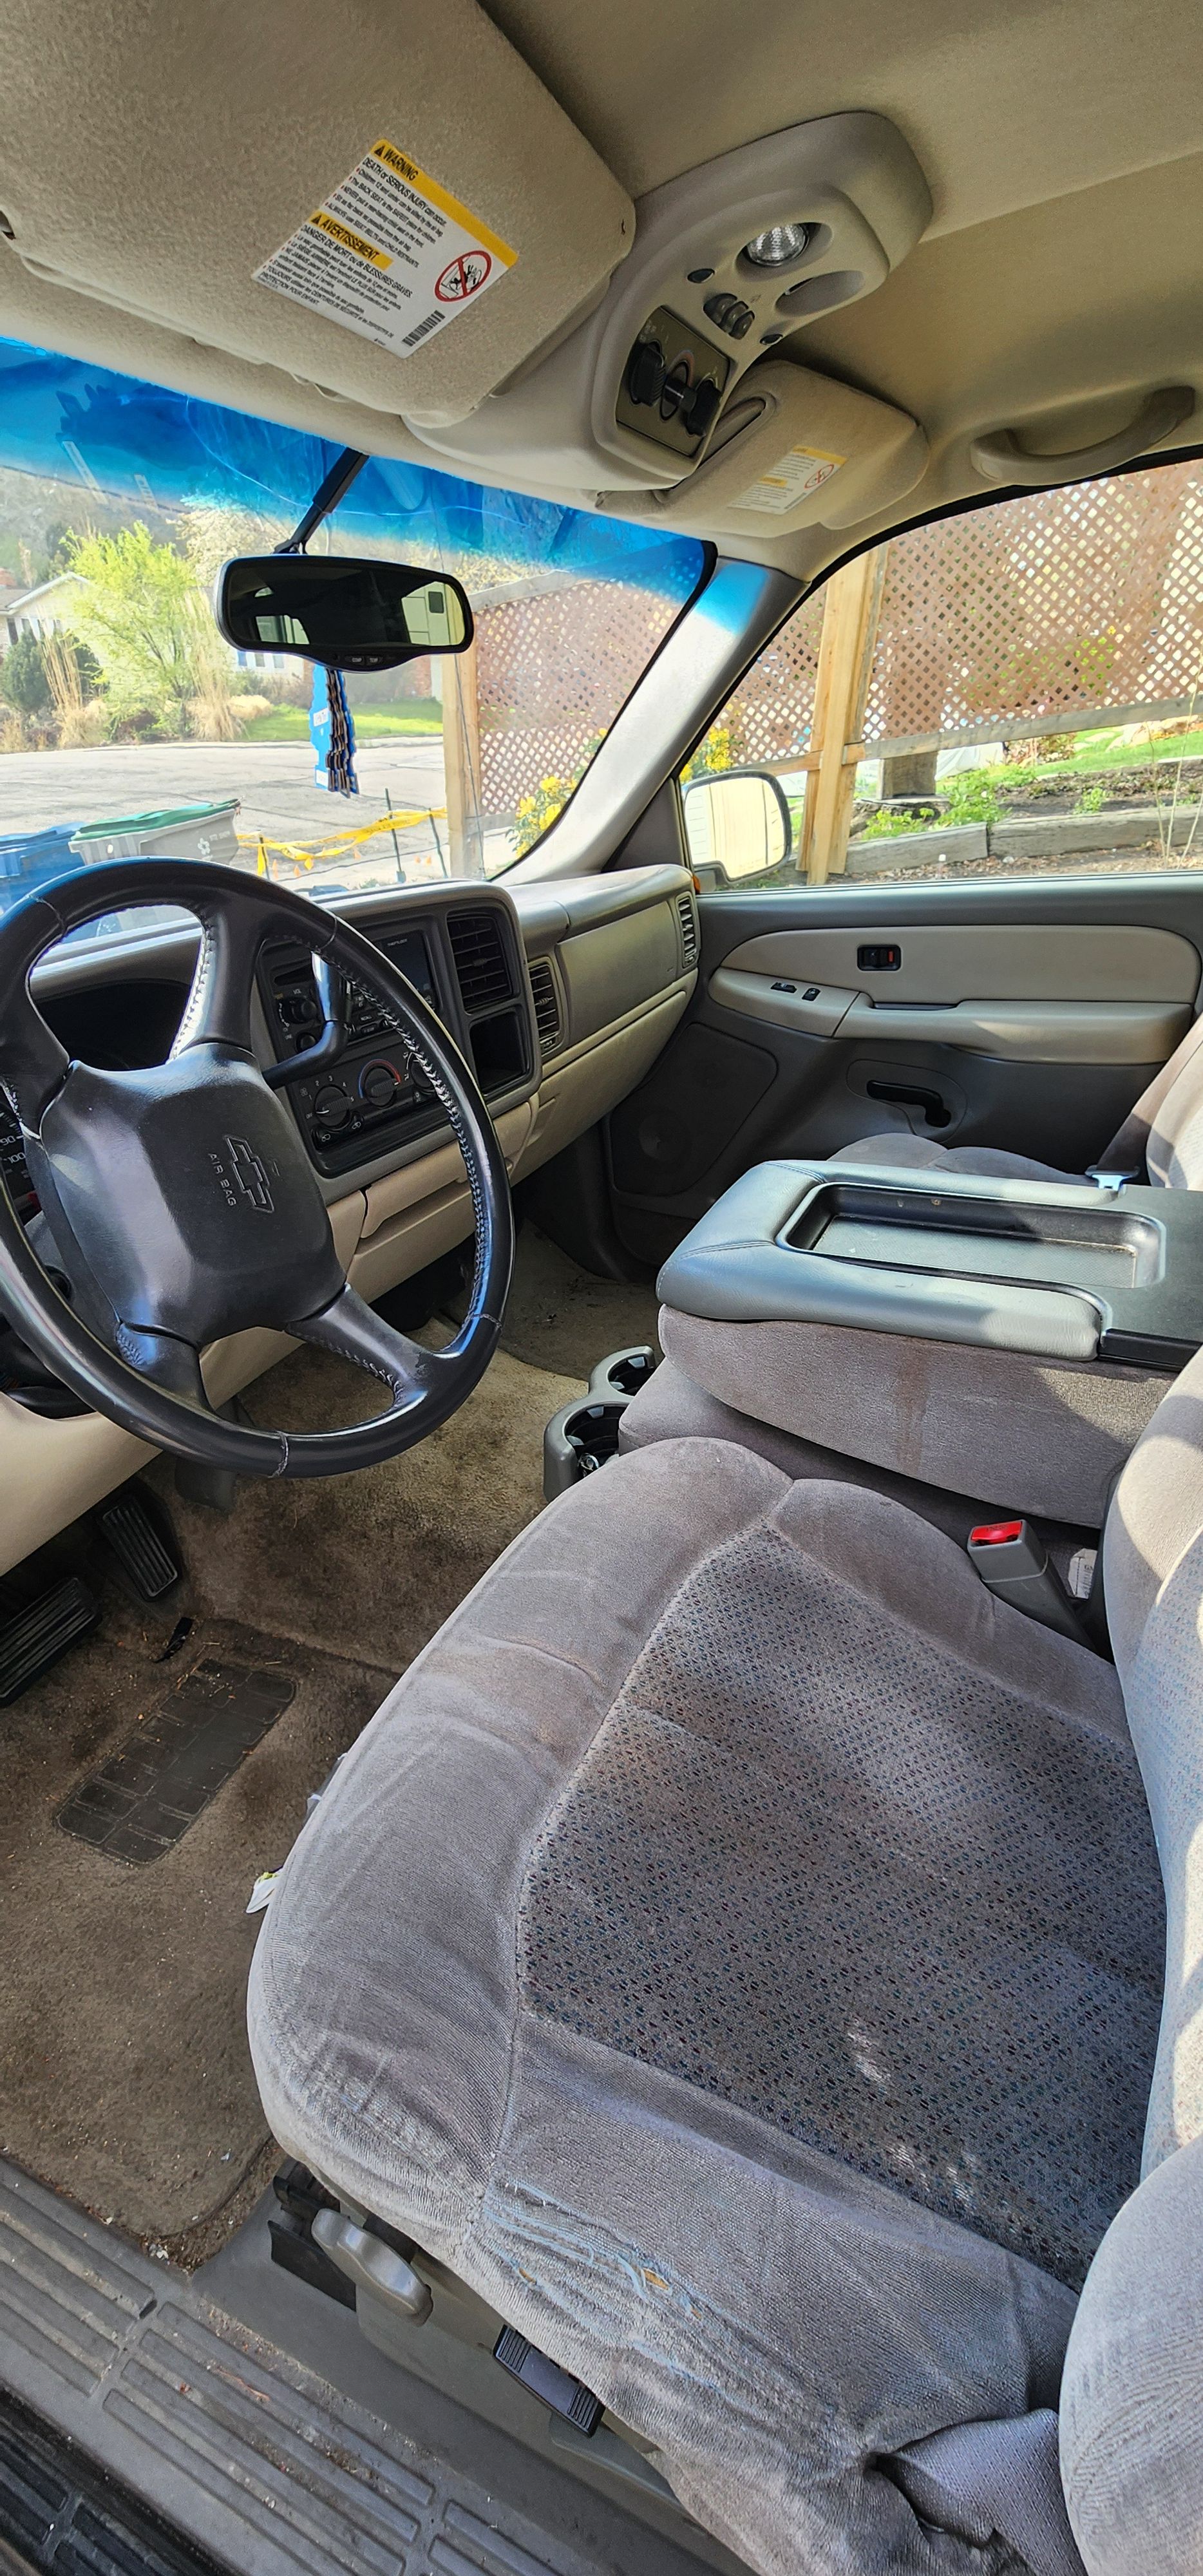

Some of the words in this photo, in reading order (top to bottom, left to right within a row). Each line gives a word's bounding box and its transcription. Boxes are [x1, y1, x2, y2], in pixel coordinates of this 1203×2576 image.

[362, 156, 383, 175] DEATH
[383, 149, 419, 181] WARNING
[379, 170, 390, 180] or
[342, 186, 359, 199] NEVER
[357, 183, 372, 195] BACK
[369, 192, 383, 204] SEAT
[384, 175, 412, 197] SERIOUS
[327, 202, 347, 218] ALWAYS
[407, 193, 428, 211] INJURY
[319, 218, 380, 261] AVERTISSEMENT
[290, 251, 310, 263] JAMAIS
[300, 224, 327, 243] DANGER
[323, 239, 336, 249] DE
[332, 244, 352, 259] MORT
[355, 259, 366, 267] de
[362, 263, 395, 285] BLESSURES
[265, 265, 292, 281] TOUJOURS
[0, 1135, 16, 1146] 90
[7, 1152, 25, 1164] 100
[208, 1153, 225, 1174] AIR
[220, 1179, 238, 1207] BAG
